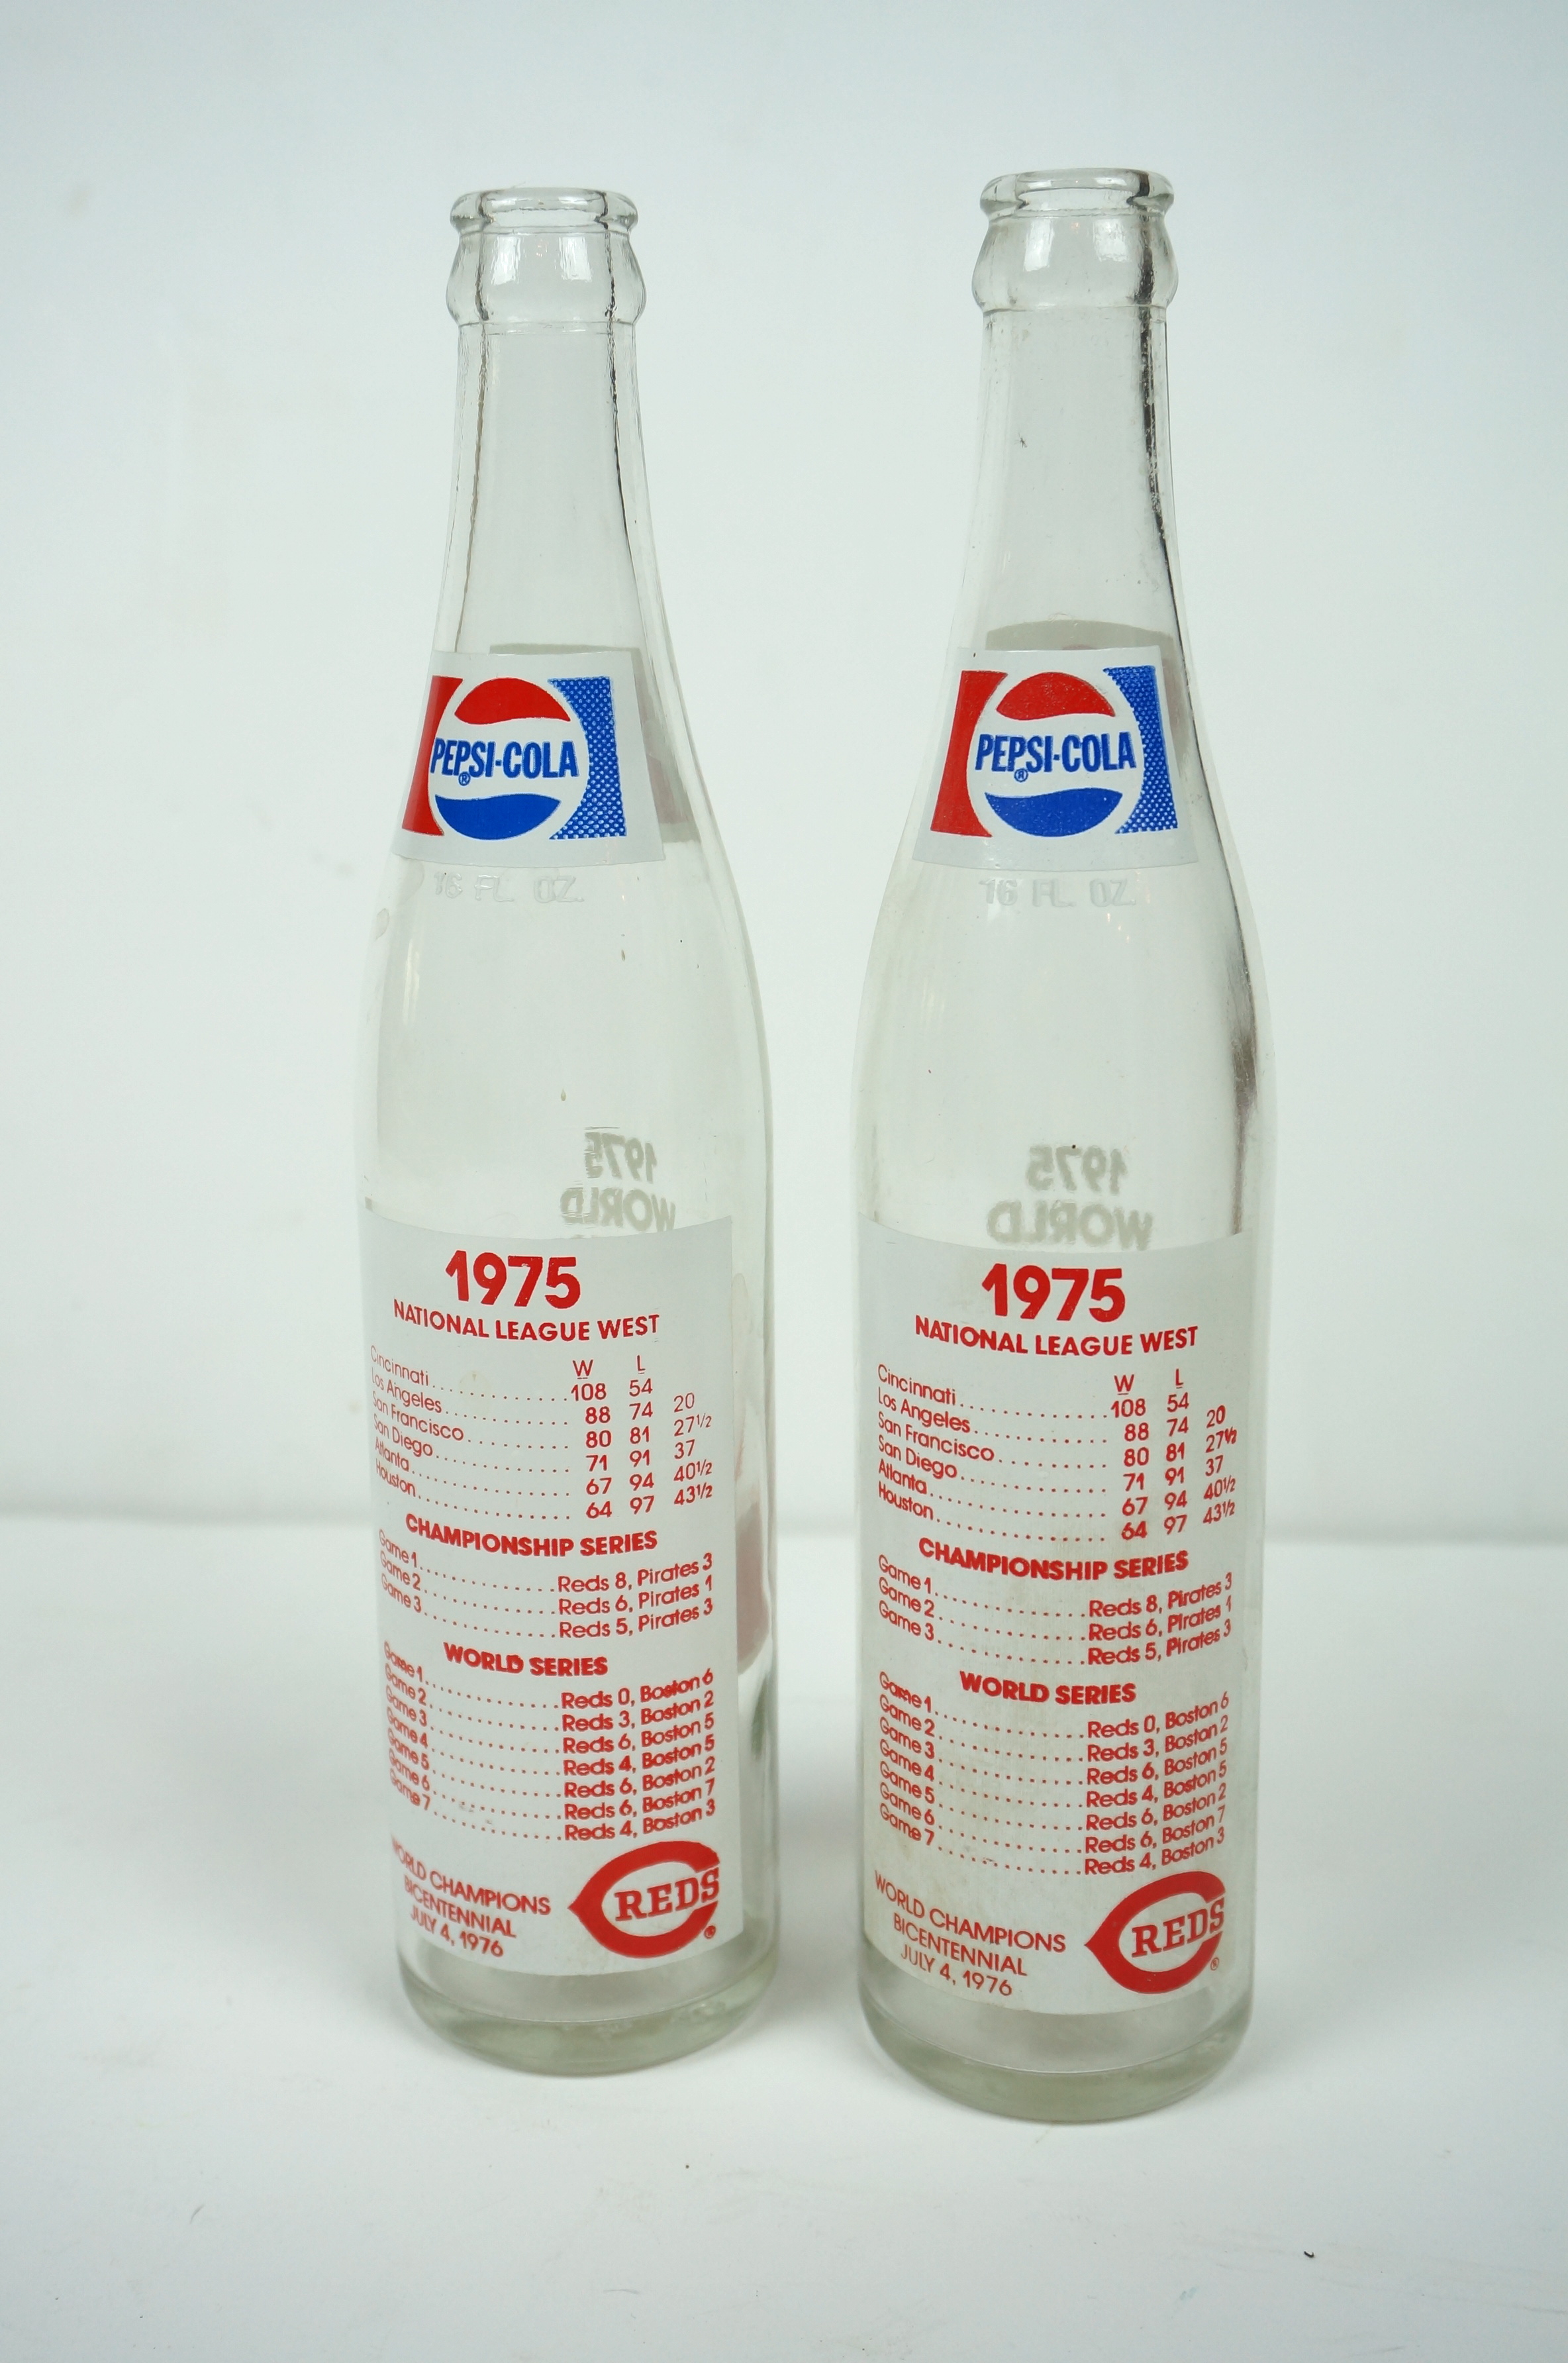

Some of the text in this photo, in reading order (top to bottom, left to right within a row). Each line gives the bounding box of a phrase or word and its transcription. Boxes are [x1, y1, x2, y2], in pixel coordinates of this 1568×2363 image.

[430, 737, 579, 778] PEPSI-COLA
[975, 731, 1138, 774] PEPSI-COLA
[434, 871, 463, 899] 16
[979, 878, 1018, 907] 16
[446, 1251, 580, 1309] 1975
[982, 1264, 1125, 1322] 1975
[395, 1299, 659, 1341] NATIONAL LEAGUE WEST
[916, 1315, 1197, 1356] NATIONAL LEAGUE WEST
[371, 1346, 653, 1401] Cincinnati 108 54
[572, 1356, 646, 1378] W L
[879, 1365, 1189, 1417] Cincinnati 108 54
[1114, 1369, 1184, 1391] W L
[387, 1380, 653, 1424] Angeles 88 74
[392, 1404, 650, 1448] Francisco 80 81
[879, 1387, 1189, 1441] Los Angeles 88 74
[393, 1427, 650, 1471] Diego 71 91
[879, 1412, 1185, 1466] San Francisco 80 81
[879, 1435, 1185, 1491] San Diego 71 91
[376, 1439, 654, 1495] Atlanta 67 94
[377, 1461, 654, 1518] Houston 64 97
[879, 1460, 1187, 1516] Atlanta 67 94
[406, 1513, 657, 1556] CHAMPIONSHIP SERIES
[879, 1482, 1187, 1540] Houston 64 97
[558, 1562, 699, 1592] Reds 8, Pirates
[919, 1538, 1188, 1580] CHAMPIONSHIP SERIES
[560, 1584, 699, 1615] Reds 6, Pirates
[879, 1555, 1221, 1617] Game 1 Reds 8, Pirates
[879, 1578, 1220, 1640] Game 2 Reds 6, Pirates
[560, 1607, 699, 1638] Reds 5, Pirates
[879, 1601, 1220, 1664] Game 3 Reds 5, Pirates
[444, 1642, 607, 1676] WORLD SERIES
[562, 1677, 699, 1709] Reds Boston
[880, 1673, 1216, 1738] Game Reds 0, Boston
[960, 1671, 1136, 1705] WORLD SERIES
[562, 1699, 701, 1731] Reds Boston
[564, 1721, 701, 1753] Reds Boston
[880, 1695, 1216, 1762] Game Reds 3, Boston
[564, 1744, 701, 1776] Reds Boston
[881, 1718, 1216, 1785] Game Reds 6, Boston
[881, 1740, 1215, 1807] Game Reds 4, Boston
[565, 1766, 701, 1797] Reds Boston
[565, 1787, 701, 1819] Reds Boston
[881, 1762, 1215, 1830] Game Reds 6, Boston
[565, 1808, 702, 1840] Reds Boston
[881, 1784, 1214, 1853] Game Reds 6, Boston
[881, 1805, 1214, 1874] Game Reds 4, Boston
[405, 1876, 516, 1938] BICENTENNIAL
[430, 1871, 550, 1915] CHAMPIONS
[614, 1866, 719, 1921] REDS
[875, 1871, 1065, 1952] WORLD CHAMPIONS
[411, 1905, 503, 1956] JULY 4, 1976
[895, 1913, 1026, 1976] BICENTENNIAL
[1132, 1898, 1224, 1957] REDS
[902, 1945, 1012, 1995] JULY 4, 1976
